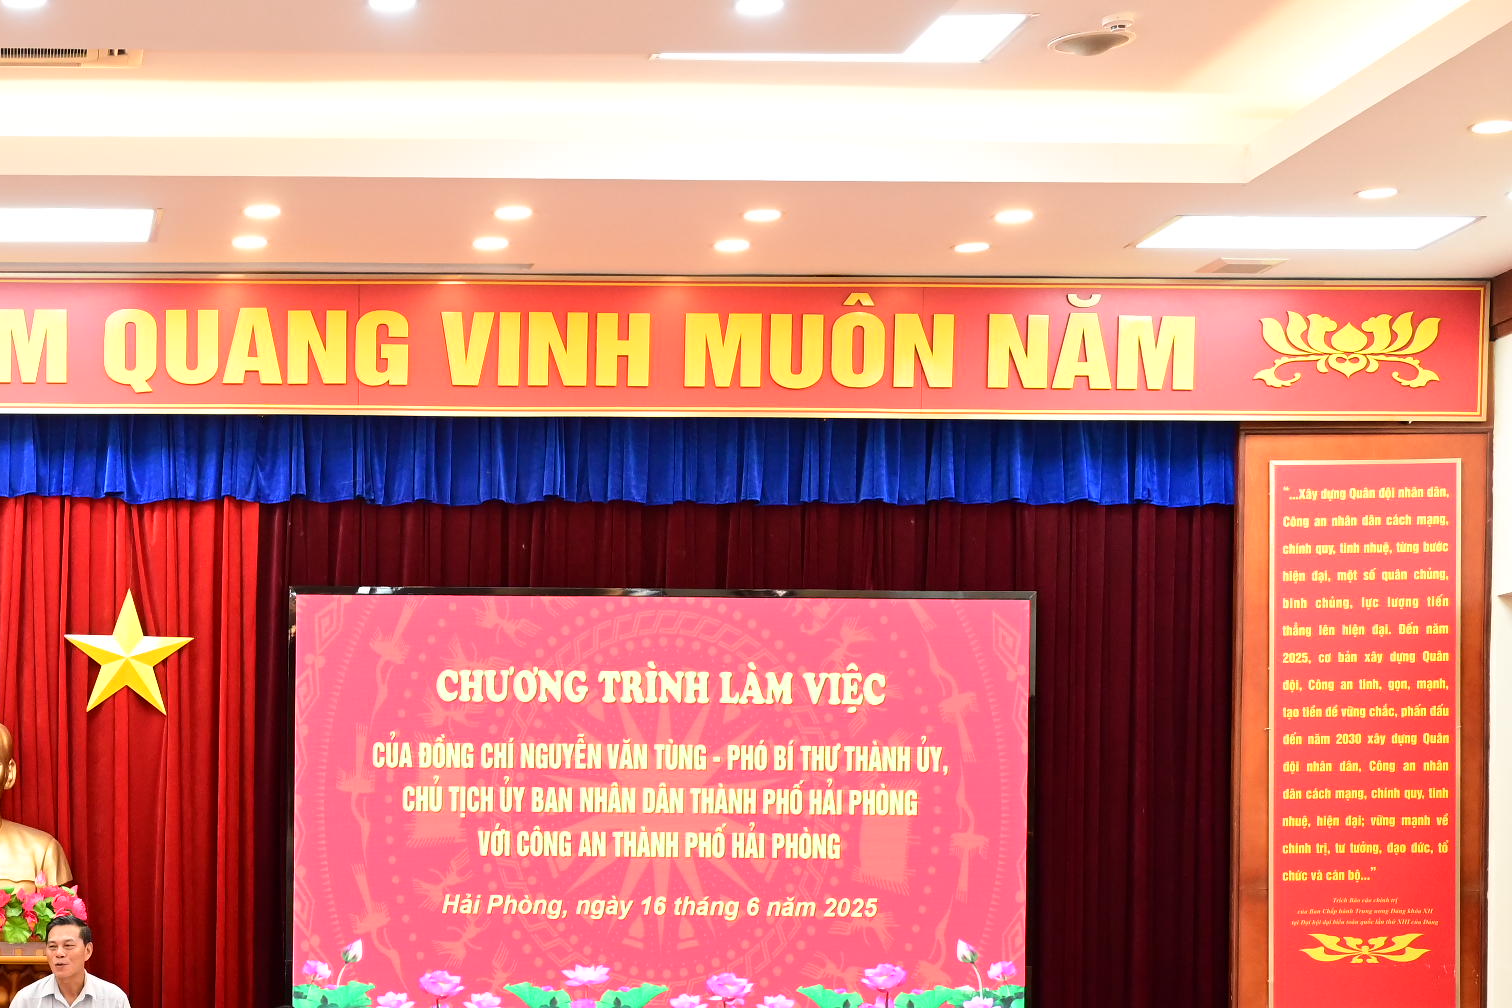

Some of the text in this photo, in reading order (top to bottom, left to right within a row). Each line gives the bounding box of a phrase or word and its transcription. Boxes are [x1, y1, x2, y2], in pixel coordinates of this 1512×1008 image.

[104, 308, 409, 393] QUANG
[441, 311, 651, 387] VINH
[684, 292, 955, 389] MUÔN
[986, 293, 1196, 391] NĂM
[436, 663, 886, 713] CHƯƠNG TRÌNH LÀM VIỆC
[373, 731, 413, 768] CỦA
[418, 734, 474, 769] ĐỒNG
[481, 737, 514, 769] CHÍ
[520, 733, 603, 769] NGUYỄN
[607, 738, 648, 770] VĂN
[654, 738, 708, 770] TÙNG
[727, 739, 768, 771] PHÓ
[774, 739, 794, 771] BÍ
[800, 743, 842, 772] THƯ
[844, 740, 911, 772] THÀNH
[917, 735, 948, 775] ỦY,
[403, 778, 918, 818] CHỦ TỊCH ỦY BAN NHÂN DÂN THÀNH PHỐ HẢI PHÒNG
[478, 823, 841, 859] VỚI CÔNG AN THÀNH PHỐ HẢI PHÒNG
[442, 893, 878, 921] Hải Phòng, ngày 16 tháng 6 năm 2025
